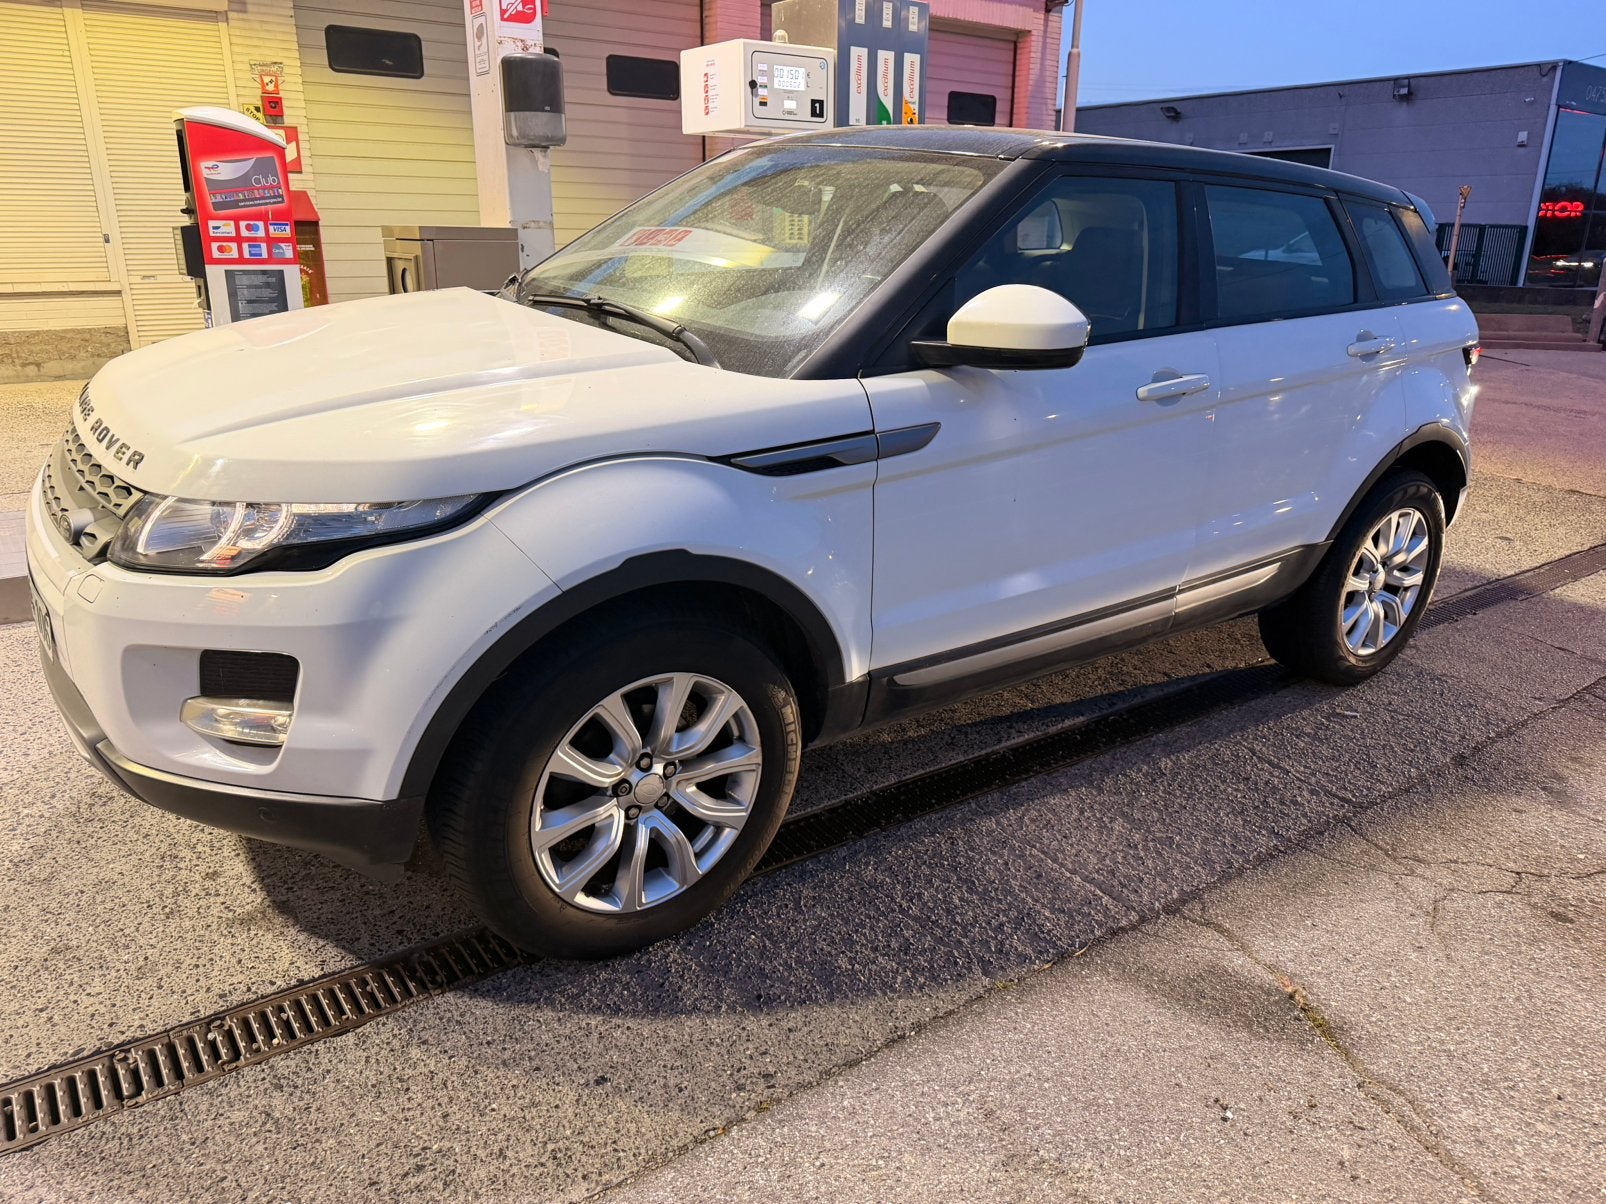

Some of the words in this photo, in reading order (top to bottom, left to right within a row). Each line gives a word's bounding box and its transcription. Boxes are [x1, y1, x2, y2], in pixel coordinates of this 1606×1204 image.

[908, 60, 916, 99] excellium
[245, 107, 261, 121] STOP
[814, 102, 820, 115] 1
[251, 173, 278, 187] Club
[90, 417, 145, 471] ROVER
